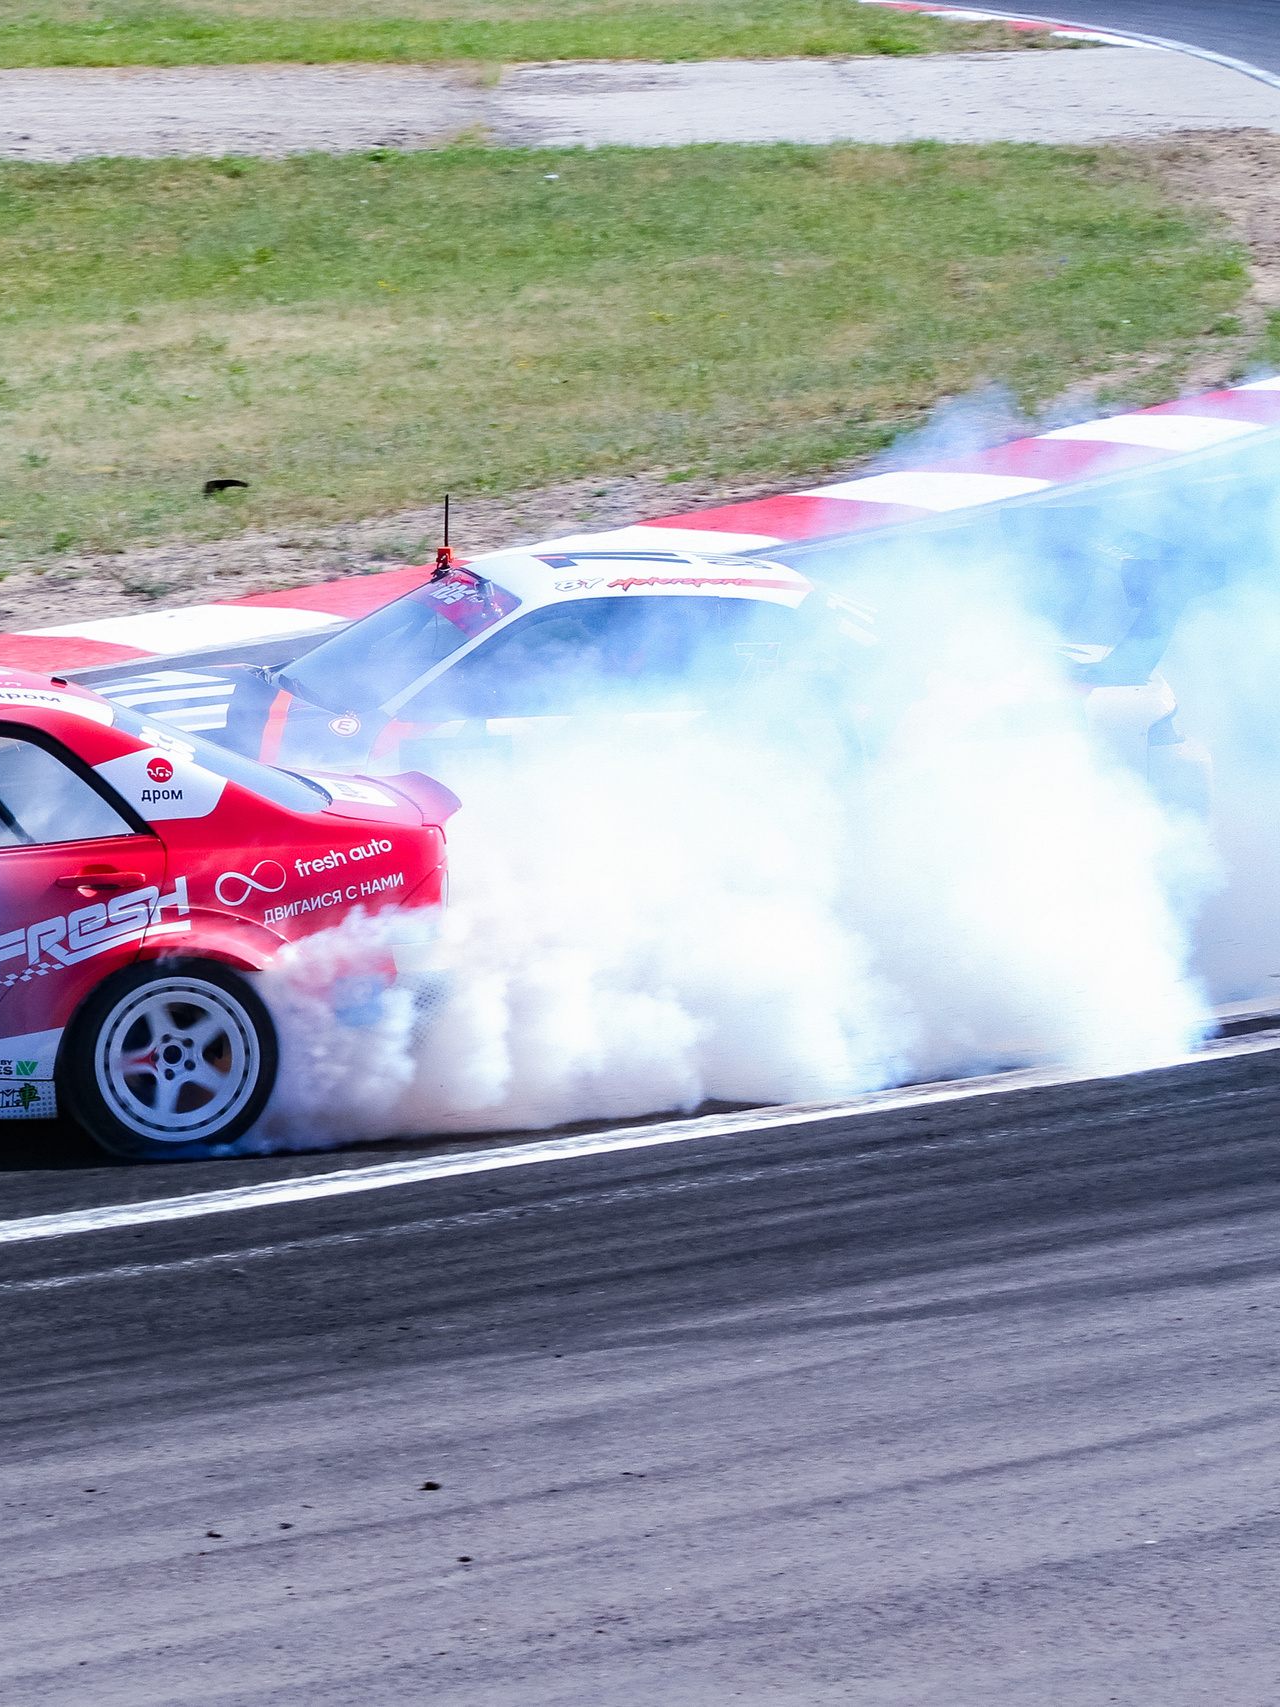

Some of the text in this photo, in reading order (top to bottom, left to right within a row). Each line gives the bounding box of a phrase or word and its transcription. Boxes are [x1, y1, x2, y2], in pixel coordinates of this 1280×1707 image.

[554, 577, 604, 592] BY
[141, 789, 183, 804] дром
[294, 837, 393, 877] fresh auto
[360, 872, 405, 897] НАМИ
